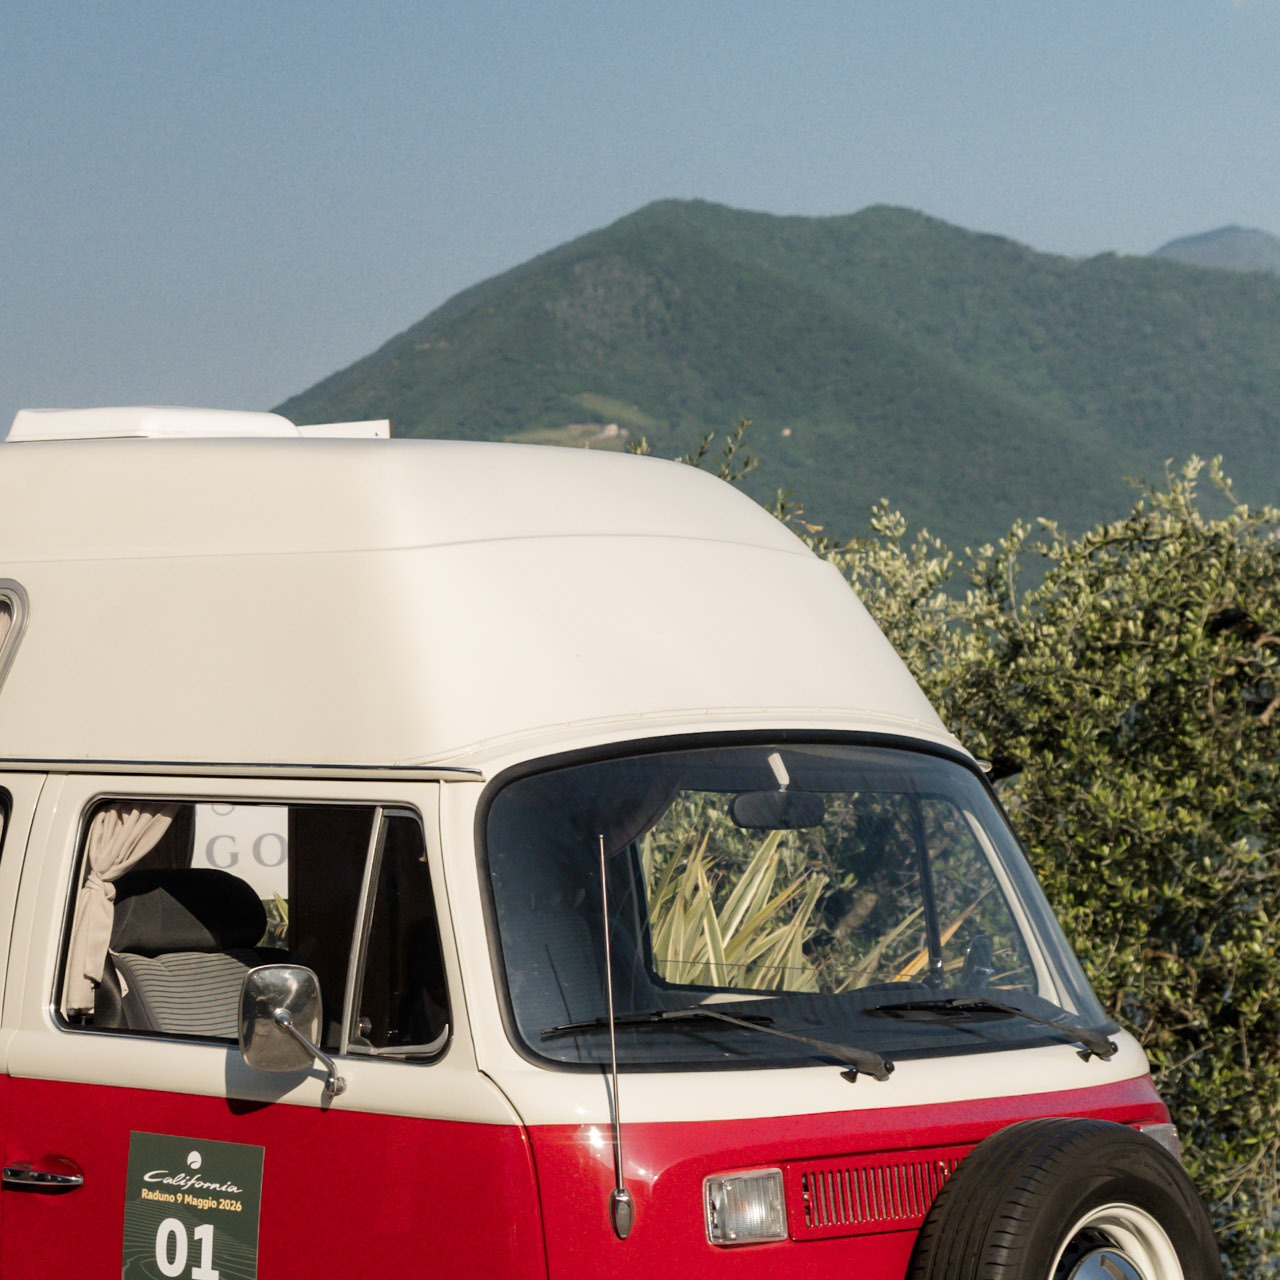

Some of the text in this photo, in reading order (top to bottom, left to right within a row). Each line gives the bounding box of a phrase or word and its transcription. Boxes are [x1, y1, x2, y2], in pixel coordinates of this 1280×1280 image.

[143, 1170, 243, 1194] California
[141, 1188, 243, 1212] Raduno 9 Maggio 2026
